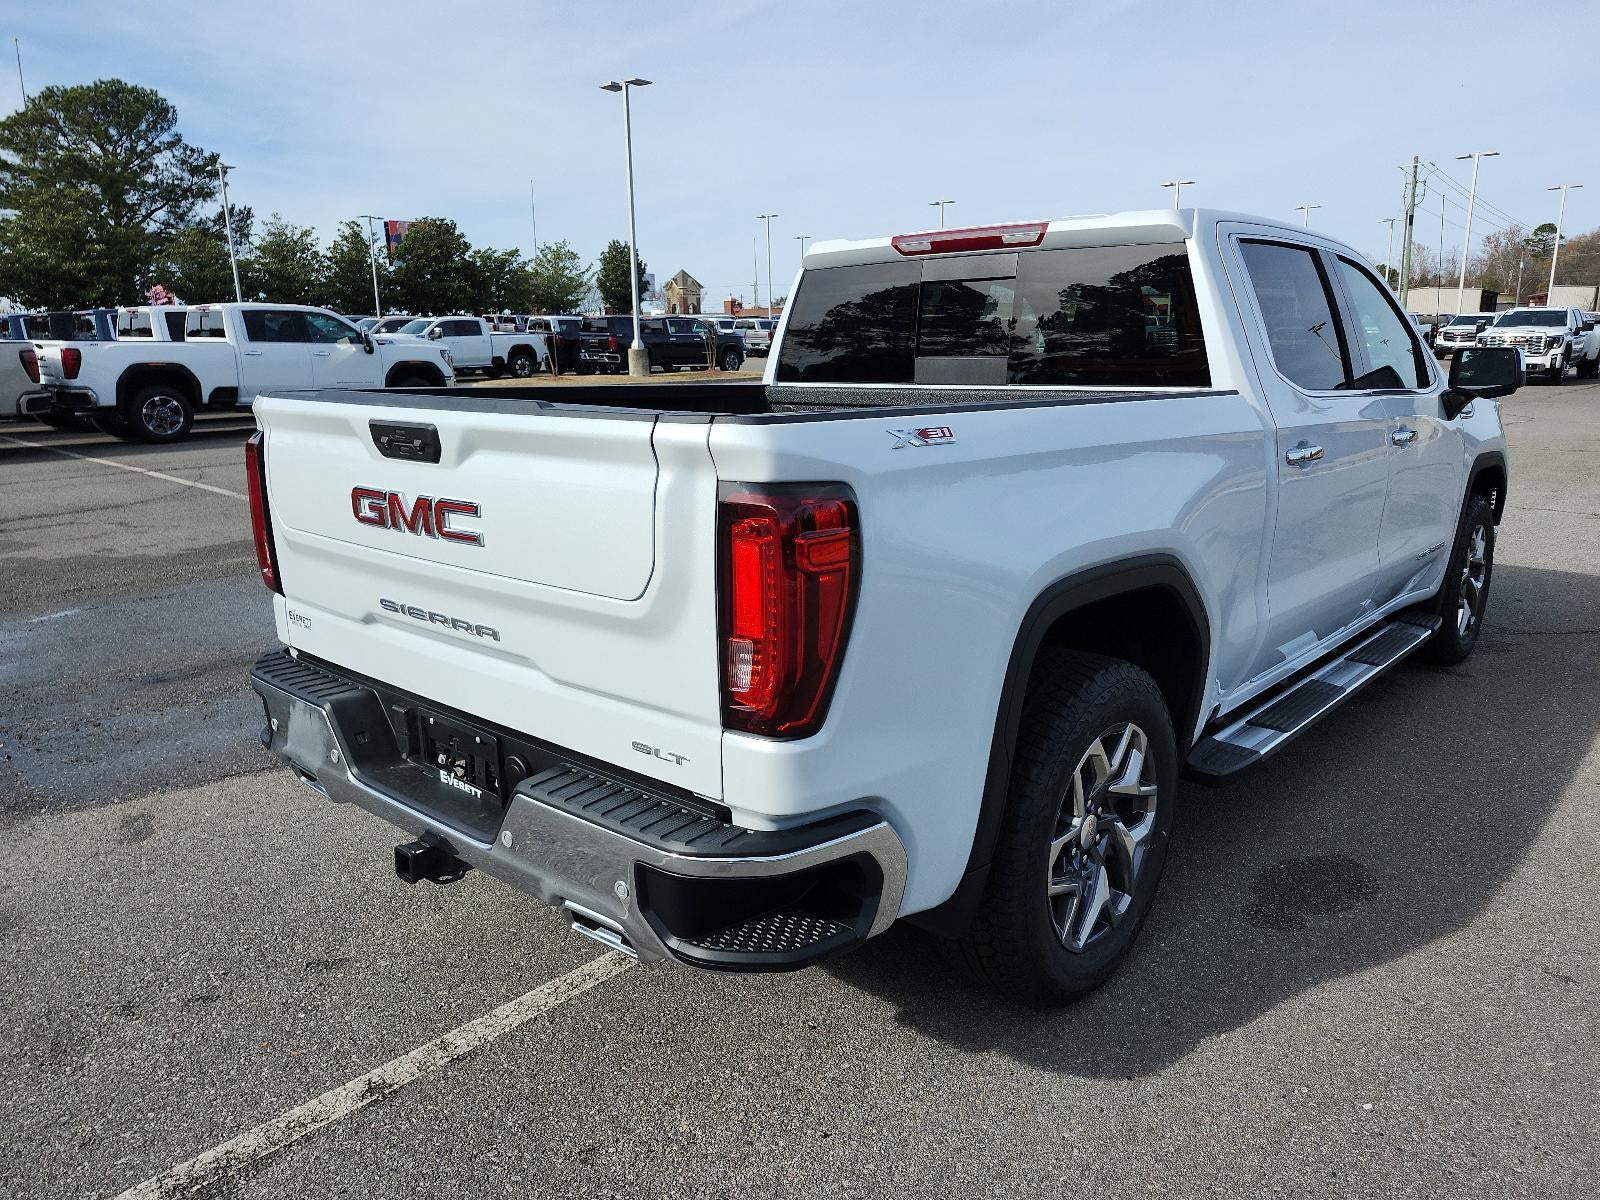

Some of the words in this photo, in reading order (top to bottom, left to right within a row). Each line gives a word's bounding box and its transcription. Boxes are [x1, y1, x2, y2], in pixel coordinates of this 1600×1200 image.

[886, 426, 956, 449] X31
[351, 485, 485, 547] GMC
[379, 598, 501, 642] SIERRA
[631, 740, 691, 766] SLT
[440, 769, 482, 799] EVERETT
